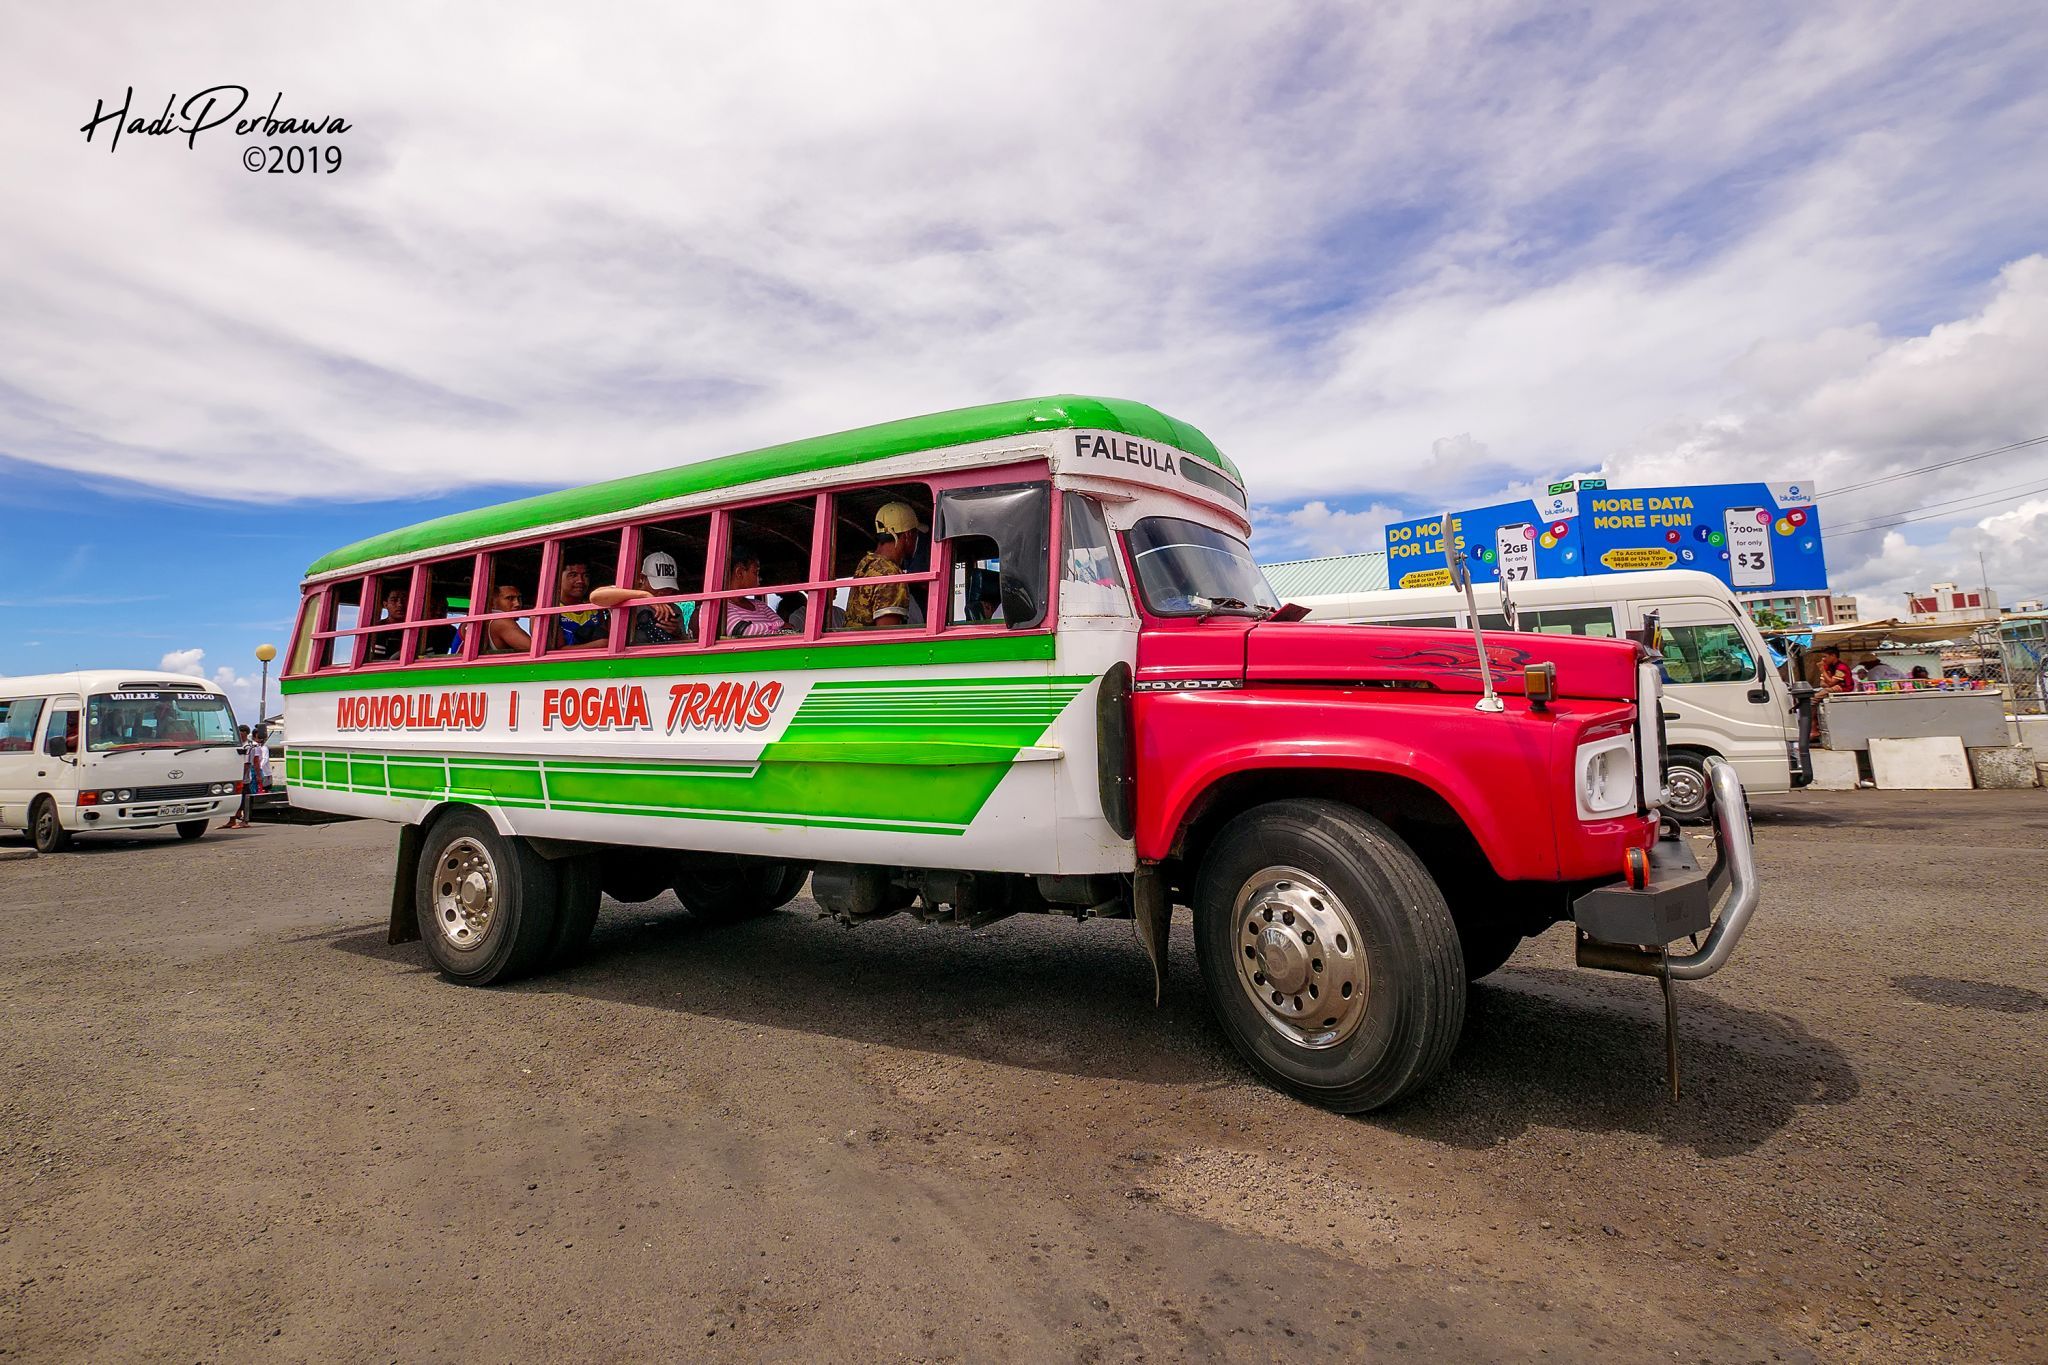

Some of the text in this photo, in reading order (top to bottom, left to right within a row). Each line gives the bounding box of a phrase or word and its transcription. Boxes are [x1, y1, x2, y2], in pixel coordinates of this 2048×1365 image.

[1075, 435, 1177, 475] FALEULA
[1592, 496, 1694, 512] MORE DATA
[1779, 494, 1811, 502] bluesky
[1544, 507, 1573, 516] bluesky
[1594, 513, 1692, 529] MORE FUN!
[1389, 518, 1462, 542] DO MOE
[1389, 535, 1466, 559] FOR LES
[1503, 543, 1528, 554] 2GB
[1747, 539, 1762, 547] only
[1738, 552, 1765, 570] $3
[655, 563, 675, 577] VIBES
[1507, 566, 1529, 581] $7
[1137, 680, 1235, 690] TOYOTA
[665, 680, 783, 736] TRANS
